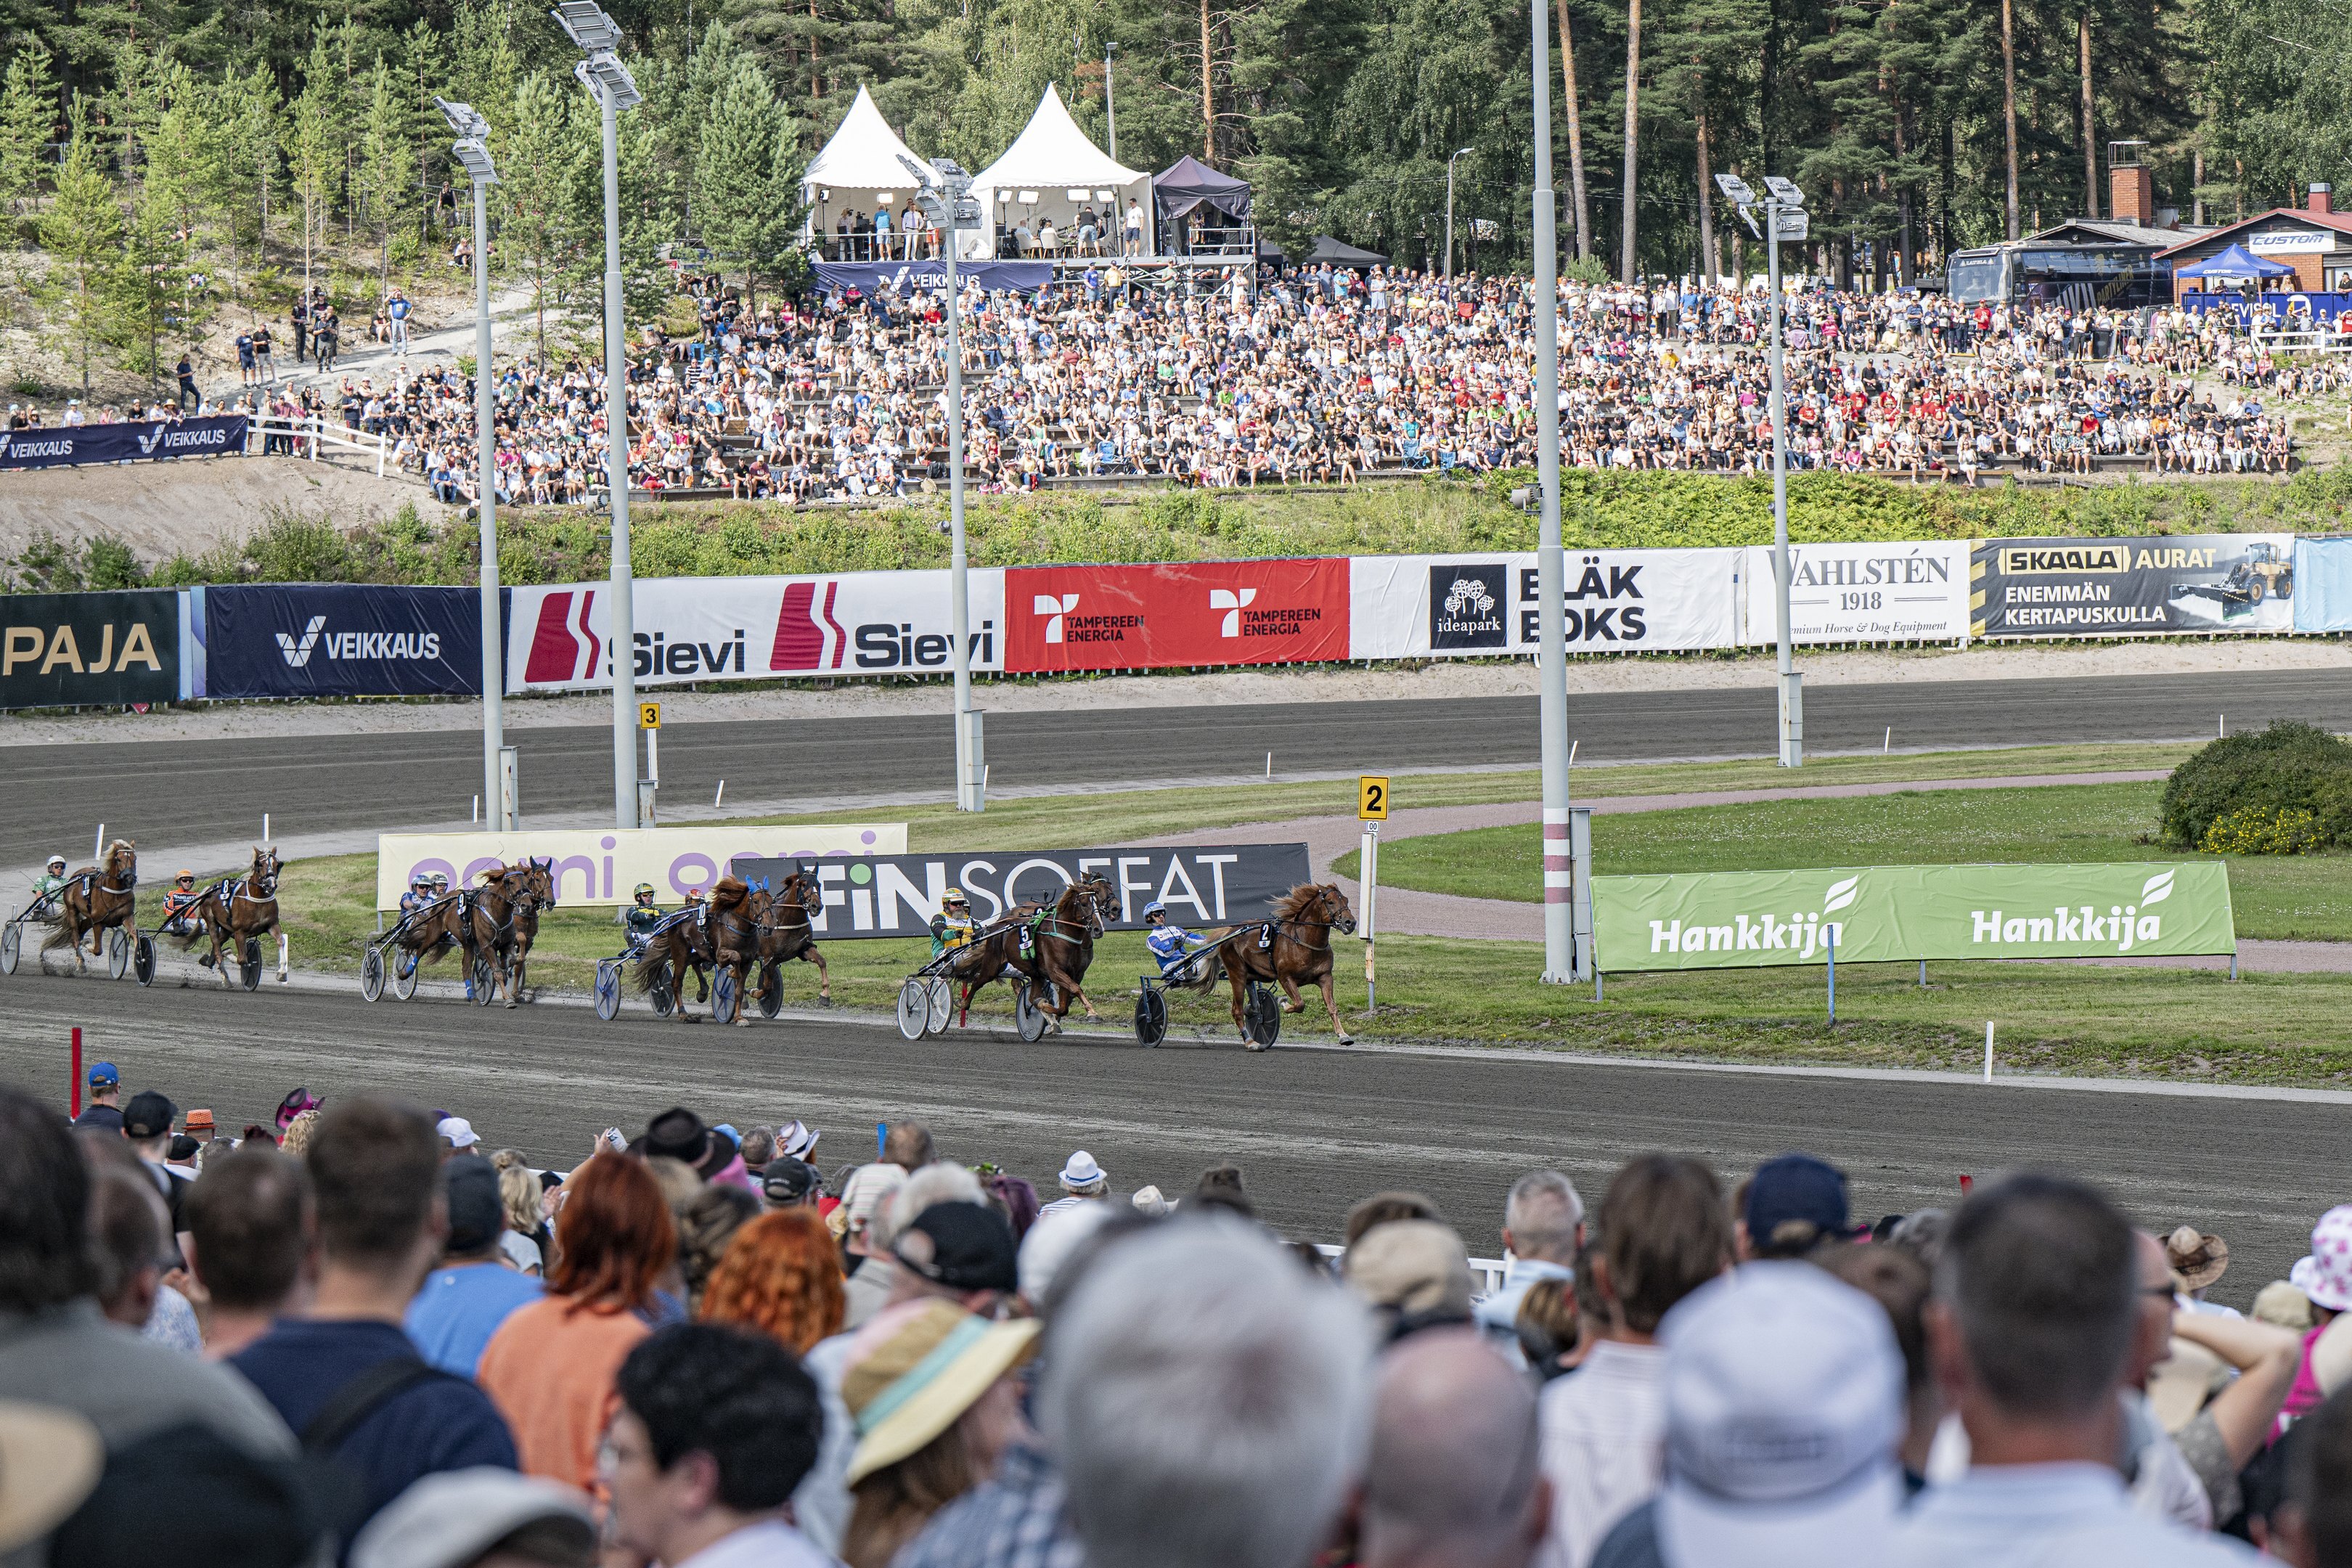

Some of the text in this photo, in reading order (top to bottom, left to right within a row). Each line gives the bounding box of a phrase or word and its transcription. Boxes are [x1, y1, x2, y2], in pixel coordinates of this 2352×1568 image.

[2253, 234, 2324, 245] CUSTOM
[164, 429, 226, 448] VEIKKAUS
[10, 439, 73, 458] VEIKKAUS
[2010, 548, 2216, 571] SKAALA AURAT
[2005, 581, 2110, 603] ENEMMÄN
[1840, 592, 1882, 610] 1918
[1066, 615, 1145, 629] TAMPEREEN
[1244, 608, 1320, 624] TAMPEREEN
[2005, 605, 2167, 625] KERTAPUSKULLA
[1244, 622, 1301, 637] ENERGIA
[1437, 616, 1501, 635] ideapark
[1789, 621, 1947, 635] emium Horse & Dog Equipment
[1066, 629, 1124, 642] ENERGIA
[2, 623, 162, 676] PAJA
[325, 632, 440, 660] VEIKKAUS
[645, 708, 656, 724] 3
[1366, 785, 1382, 812] 2
[223, 879, 229, 894] 8
[459, 893, 465, 907] 9
[698, 903, 706, 919] 10
[1021, 926, 1029, 942] 5
[1262, 923, 1269, 940] 2
[1649, 912, 1843, 959] Hankkija
[1971, 905, 2160, 951] Hankkija
